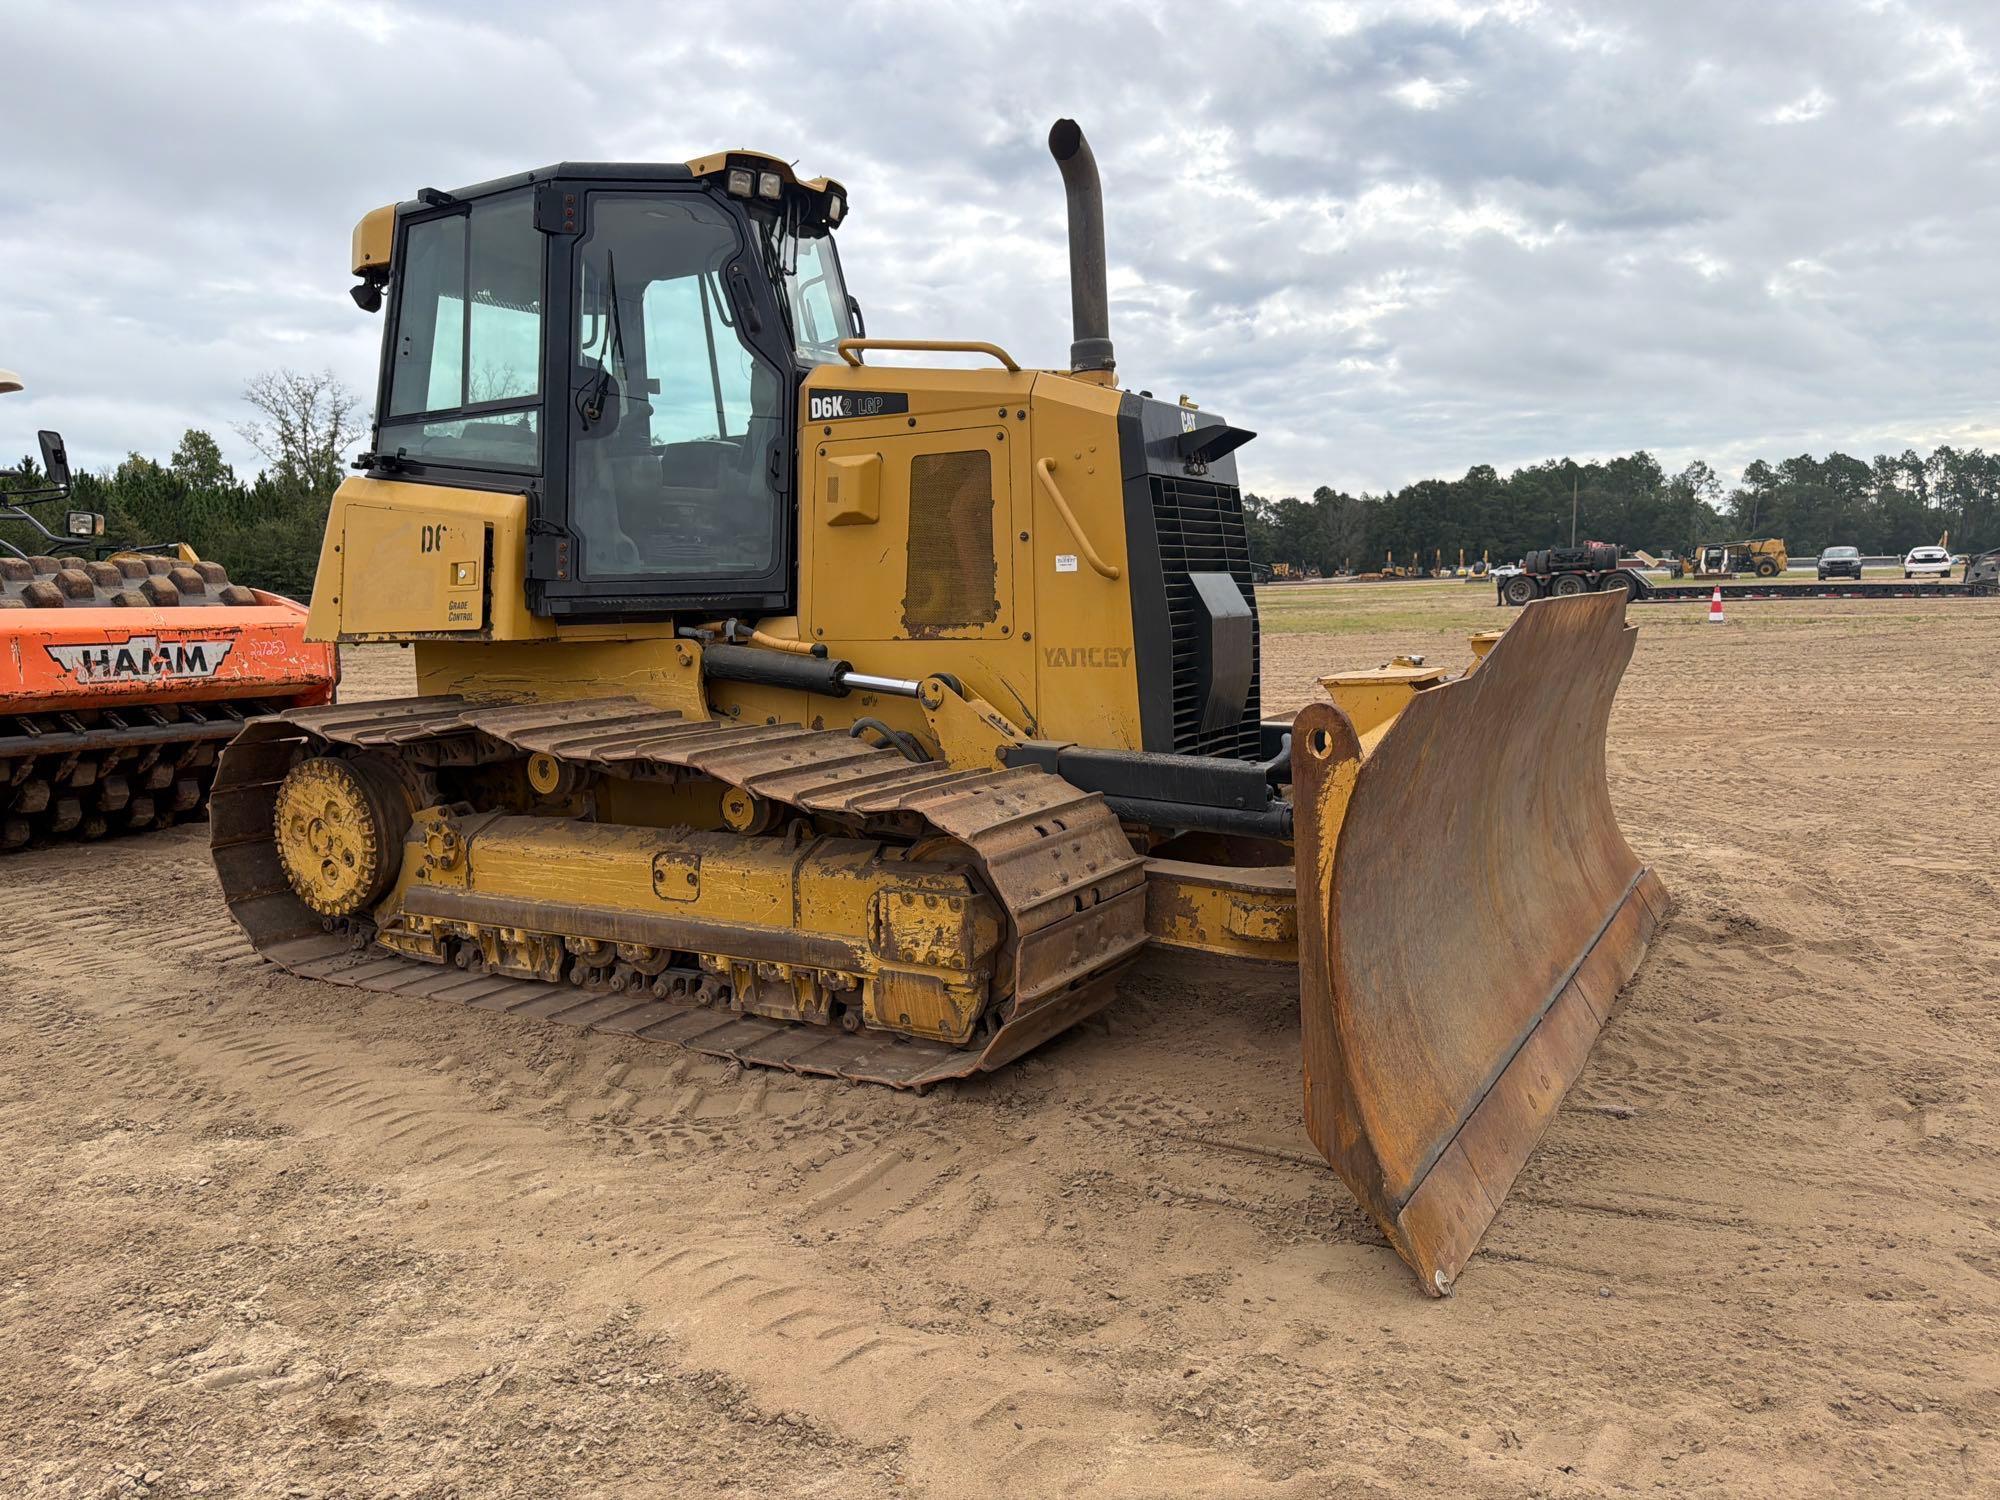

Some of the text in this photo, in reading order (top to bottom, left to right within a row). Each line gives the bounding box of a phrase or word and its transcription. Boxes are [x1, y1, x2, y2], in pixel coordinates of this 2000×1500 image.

[857, 396, 883, 415] LGP
[1180, 410, 1196, 433] CAT
[448, 600, 469, 611] GRADE
[448, 611, 473, 622] CONTROL
[82, 645, 208, 678] HAMM
[1044, 647, 1133, 668] YANCEY
